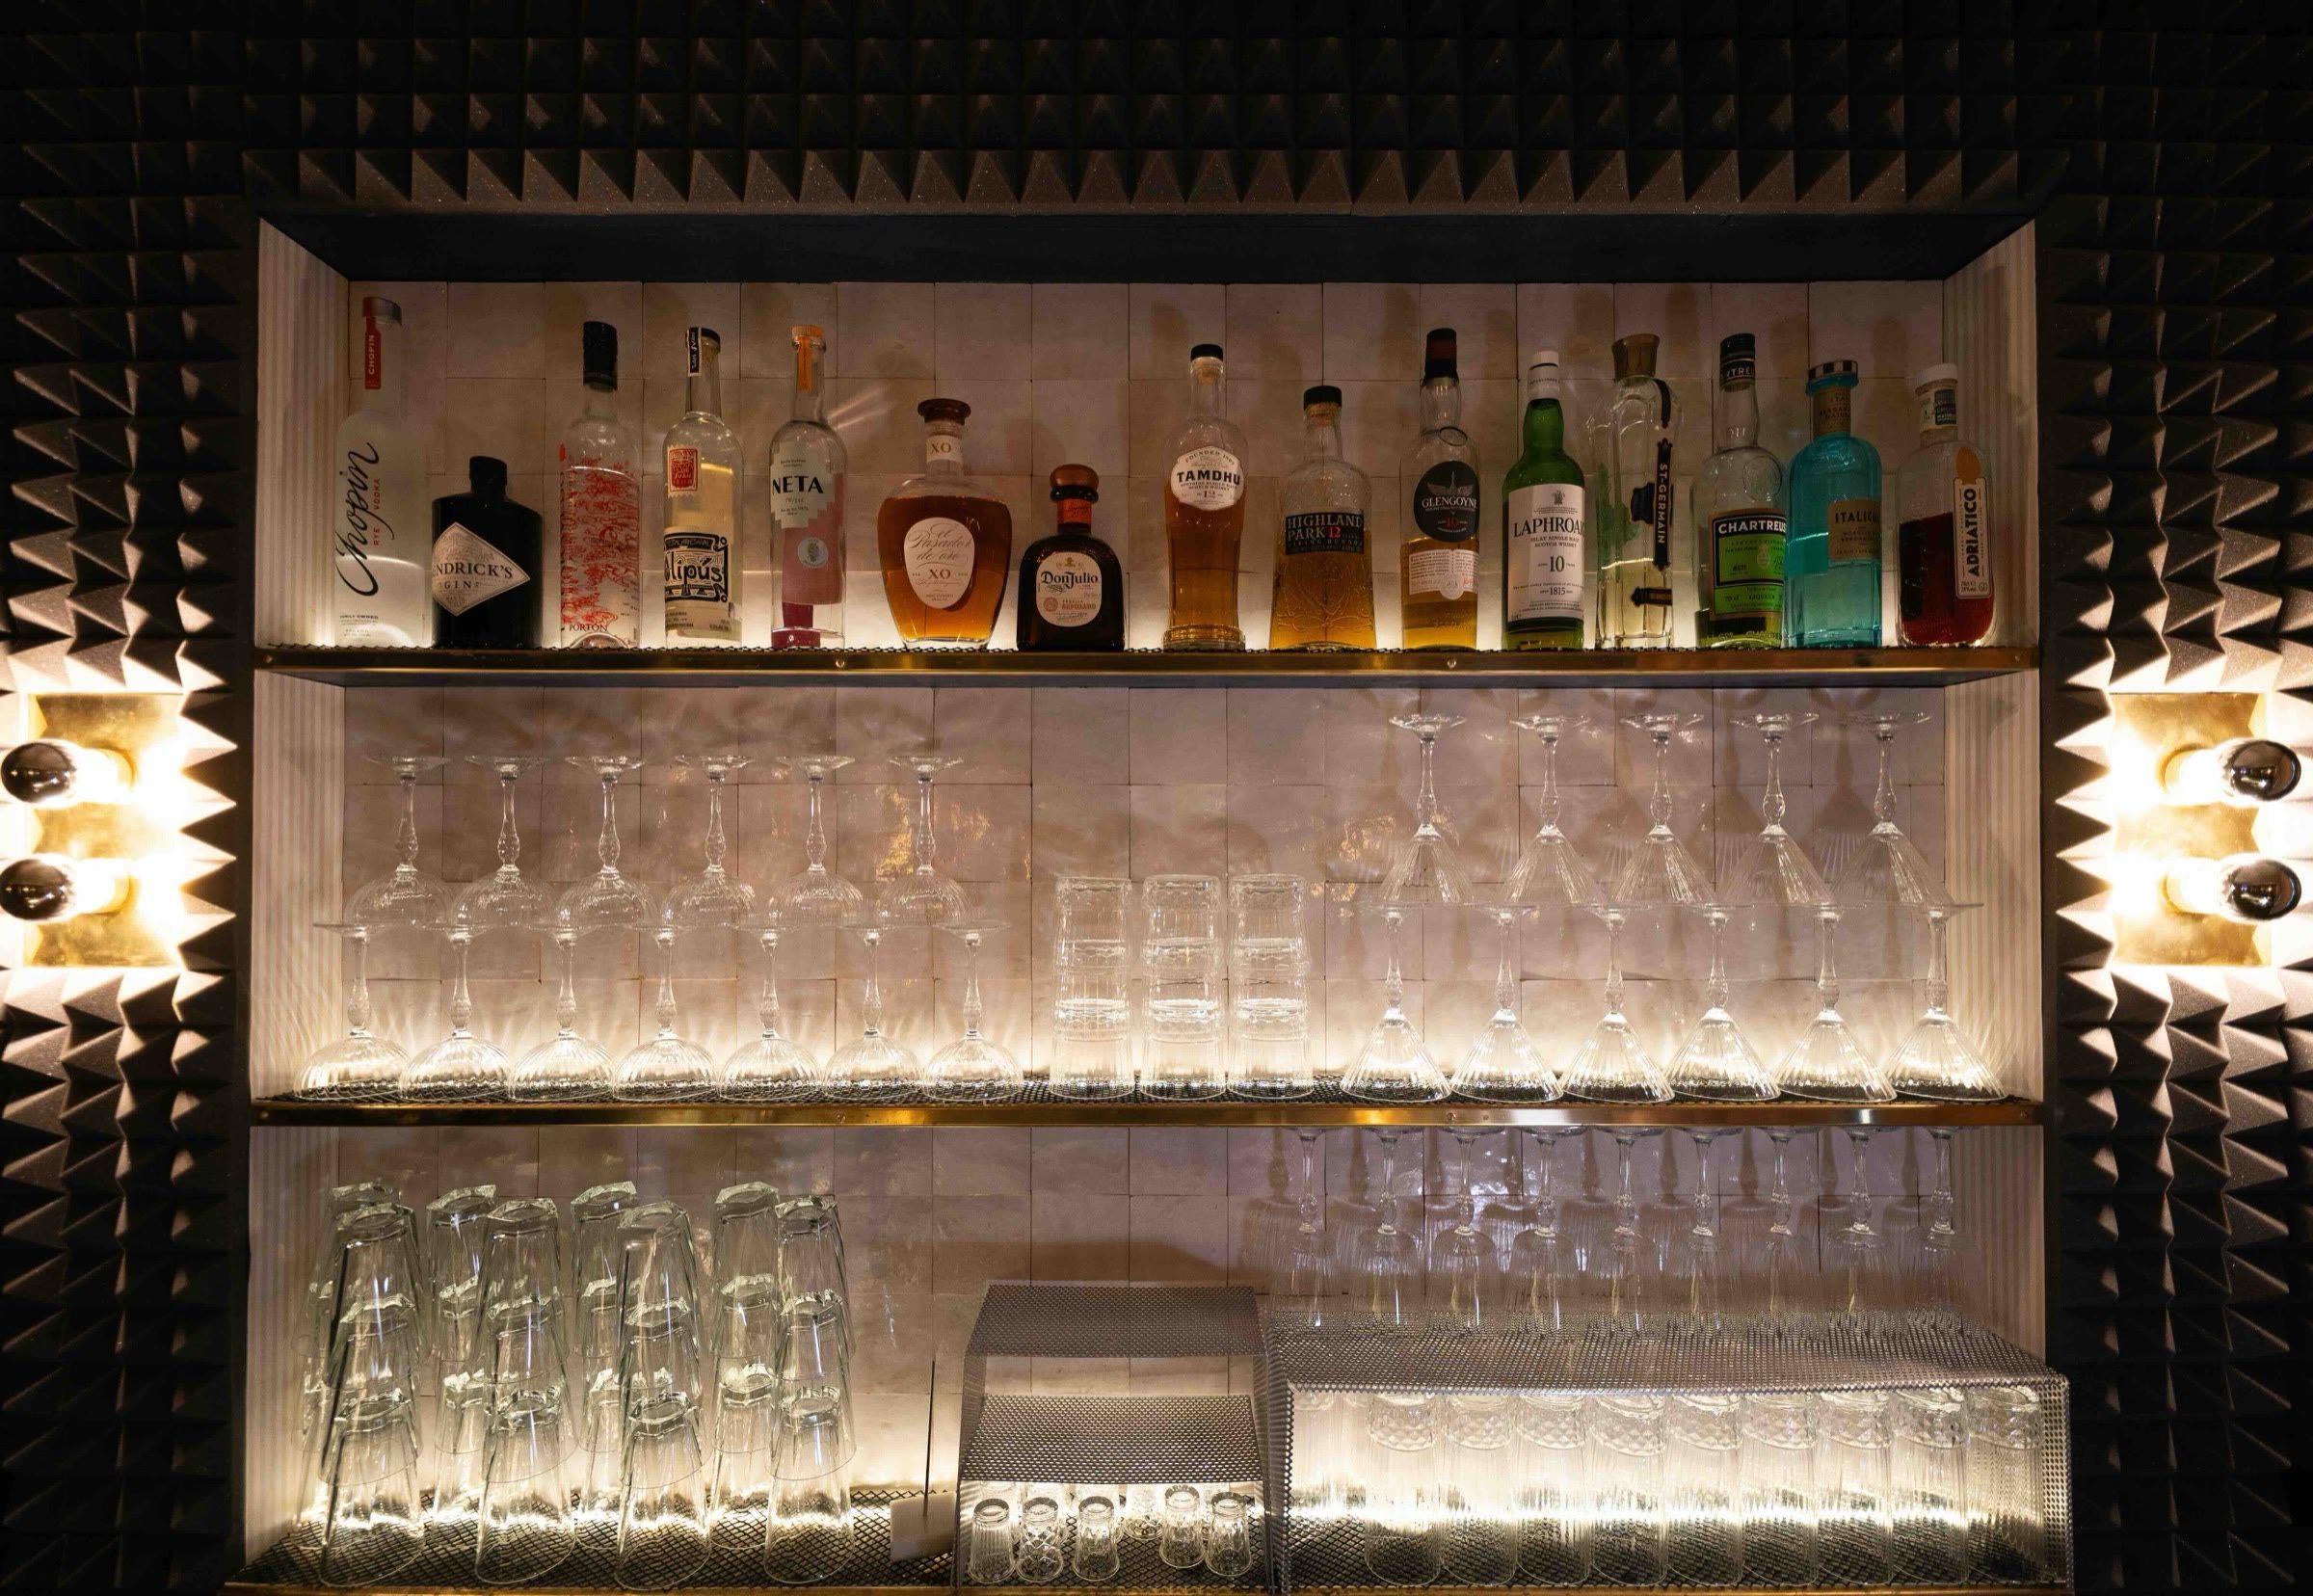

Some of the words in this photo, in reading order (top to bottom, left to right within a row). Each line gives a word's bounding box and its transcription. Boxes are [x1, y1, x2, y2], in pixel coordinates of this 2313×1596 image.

[931, 442, 952, 454] XO
[772, 475, 824, 494] NETA
[1177, 469, 1241, 486] TAMDHU
[373, 477, 382, 510] VODKA
[1657, 463, 1668, 545] ST-GERMAIN
[334, 441, 395, 597] Chopin
[1288, 514, 1364, 529] HIGHLAND
[373, 527, 382, 546] RYE
[1288, 527, 1327, 541] PARK
[1327, 526, 1341, 539] 12
[1963, 488, 1981, 577] ADRIATICO
[1550, 555, 1565, 572] 10
[928, 569, 951, 580] XO
[443, 580, 471, 589] GIN
[1550, 587, 1566, 596] 1815
